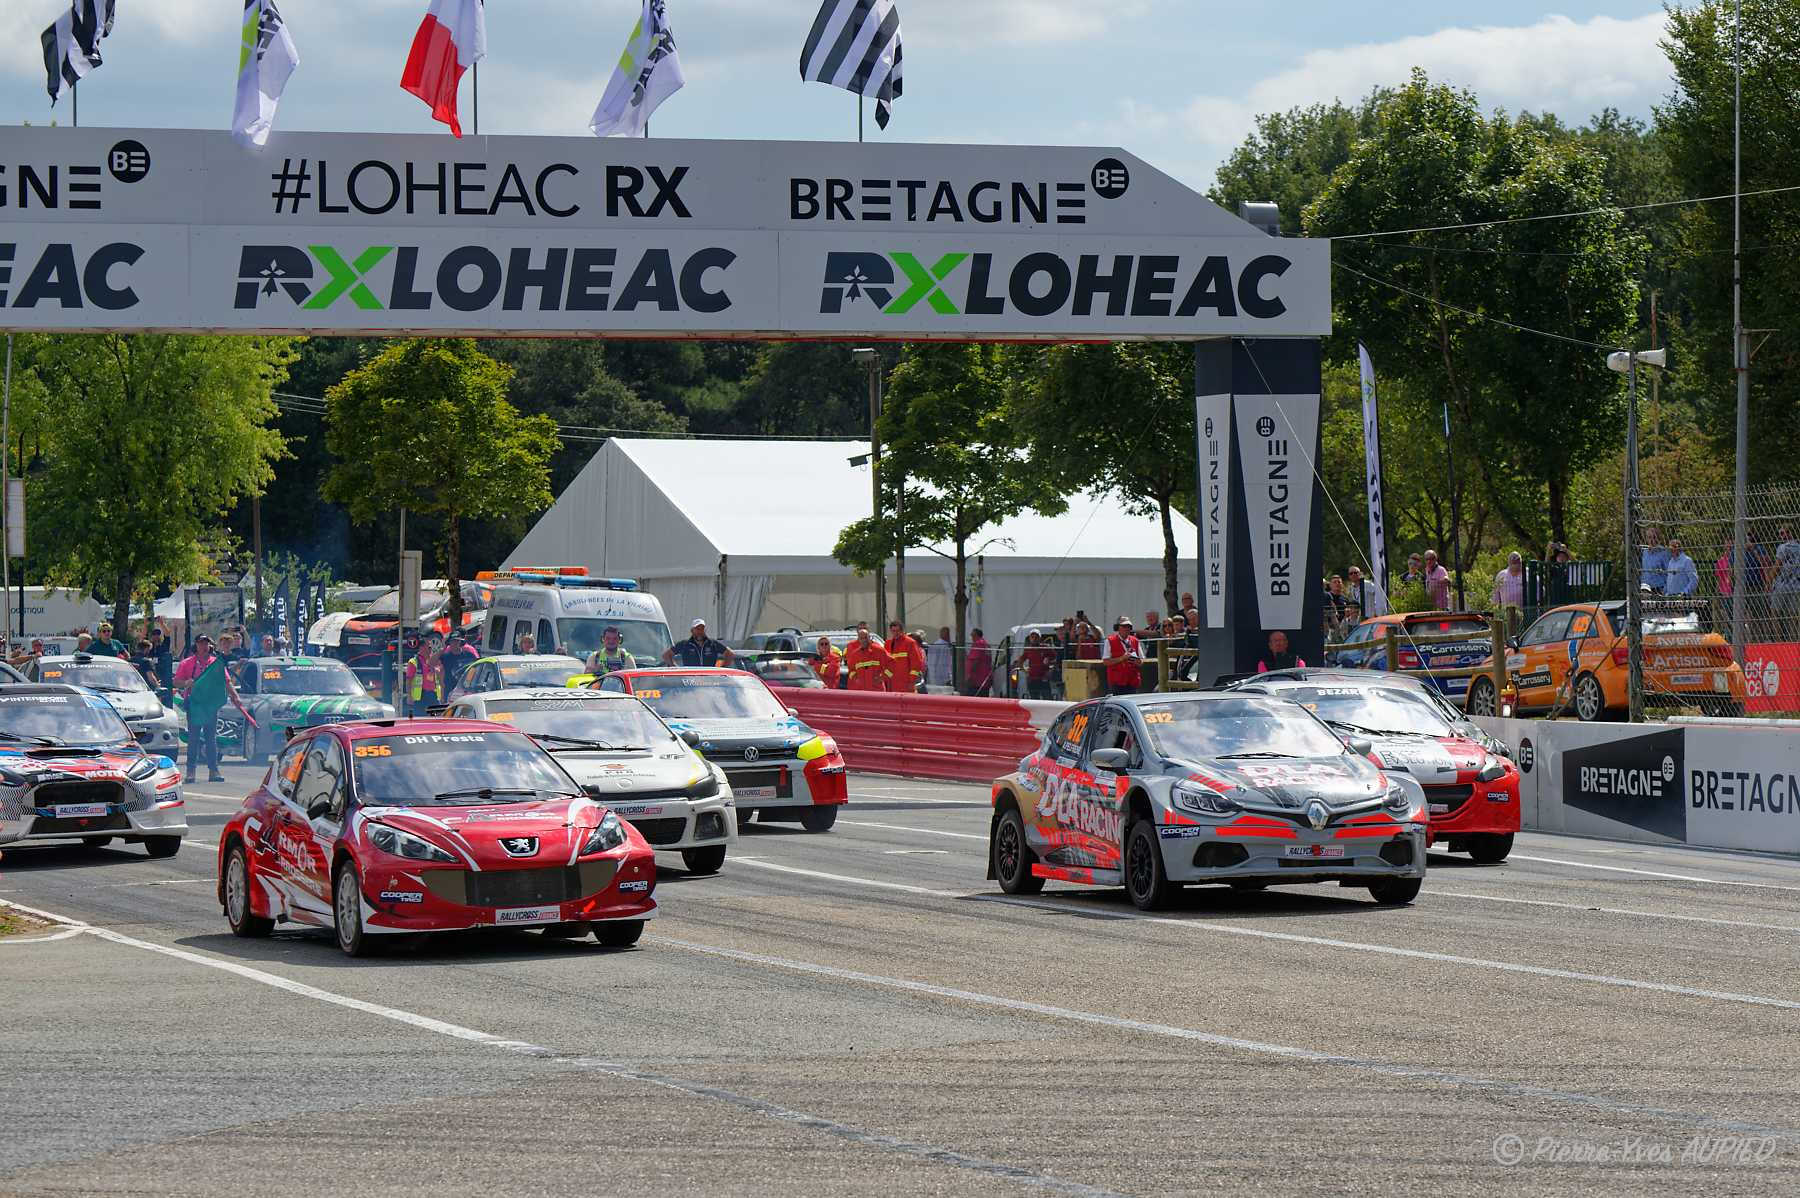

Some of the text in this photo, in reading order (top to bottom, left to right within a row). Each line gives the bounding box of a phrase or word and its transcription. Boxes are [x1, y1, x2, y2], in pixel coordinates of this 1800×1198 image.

[0, 164, 101, 209] NE
[271, 157, 692, 218] #LOHEAC RX
[790, 177, 1086, 225] BRETAGNE
[1209, 440, 1220, 595] BRETAGNE
[1268, 439, 1290, 596] BRETAGNE
[1654, 654, 1710, 668] Artisan
[526, 691, 601, 699] YACCO
[1144, 712, 1173, 723] 312
[405, 733, 485, 744] DH Presta
[355, 745, 392, 757] 356
[1580, 765, 1663, 797] BRETAGNE
[1161, 826, 1200, 835] COOPER
[619, 880, 648, 889] COOPER
[380, 891, 423, 899] COOPER
[500, 910, 538, 921] RALLYCROSS
